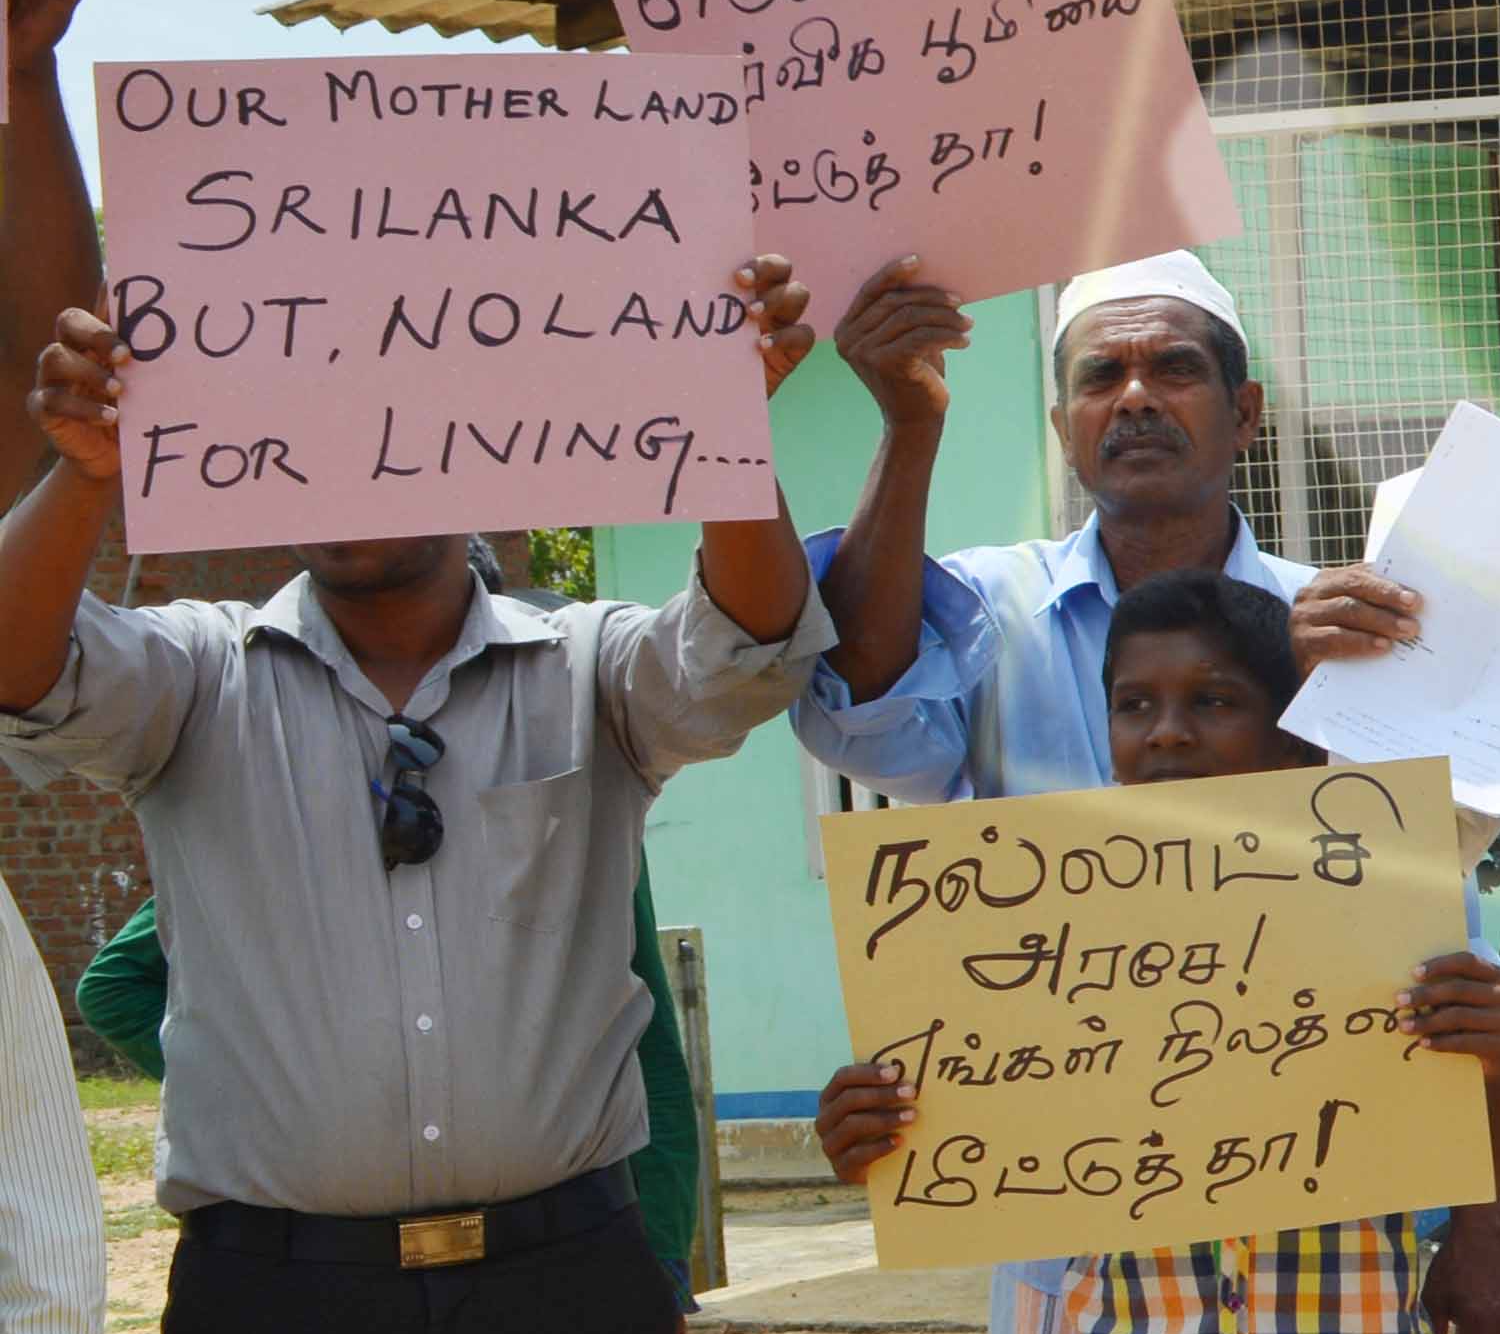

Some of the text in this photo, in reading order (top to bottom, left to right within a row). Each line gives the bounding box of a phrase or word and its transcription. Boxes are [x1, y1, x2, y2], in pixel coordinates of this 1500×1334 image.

[116, 68, 741, 133] OUR MOTHER LAND
[112, 272, 343, 365] BUT,
[141, 422, 309, 500] FOR
[865, 770, 1405, 960] நல்லாட்சி
[961, 913, 1267, 1004] அரசே!
